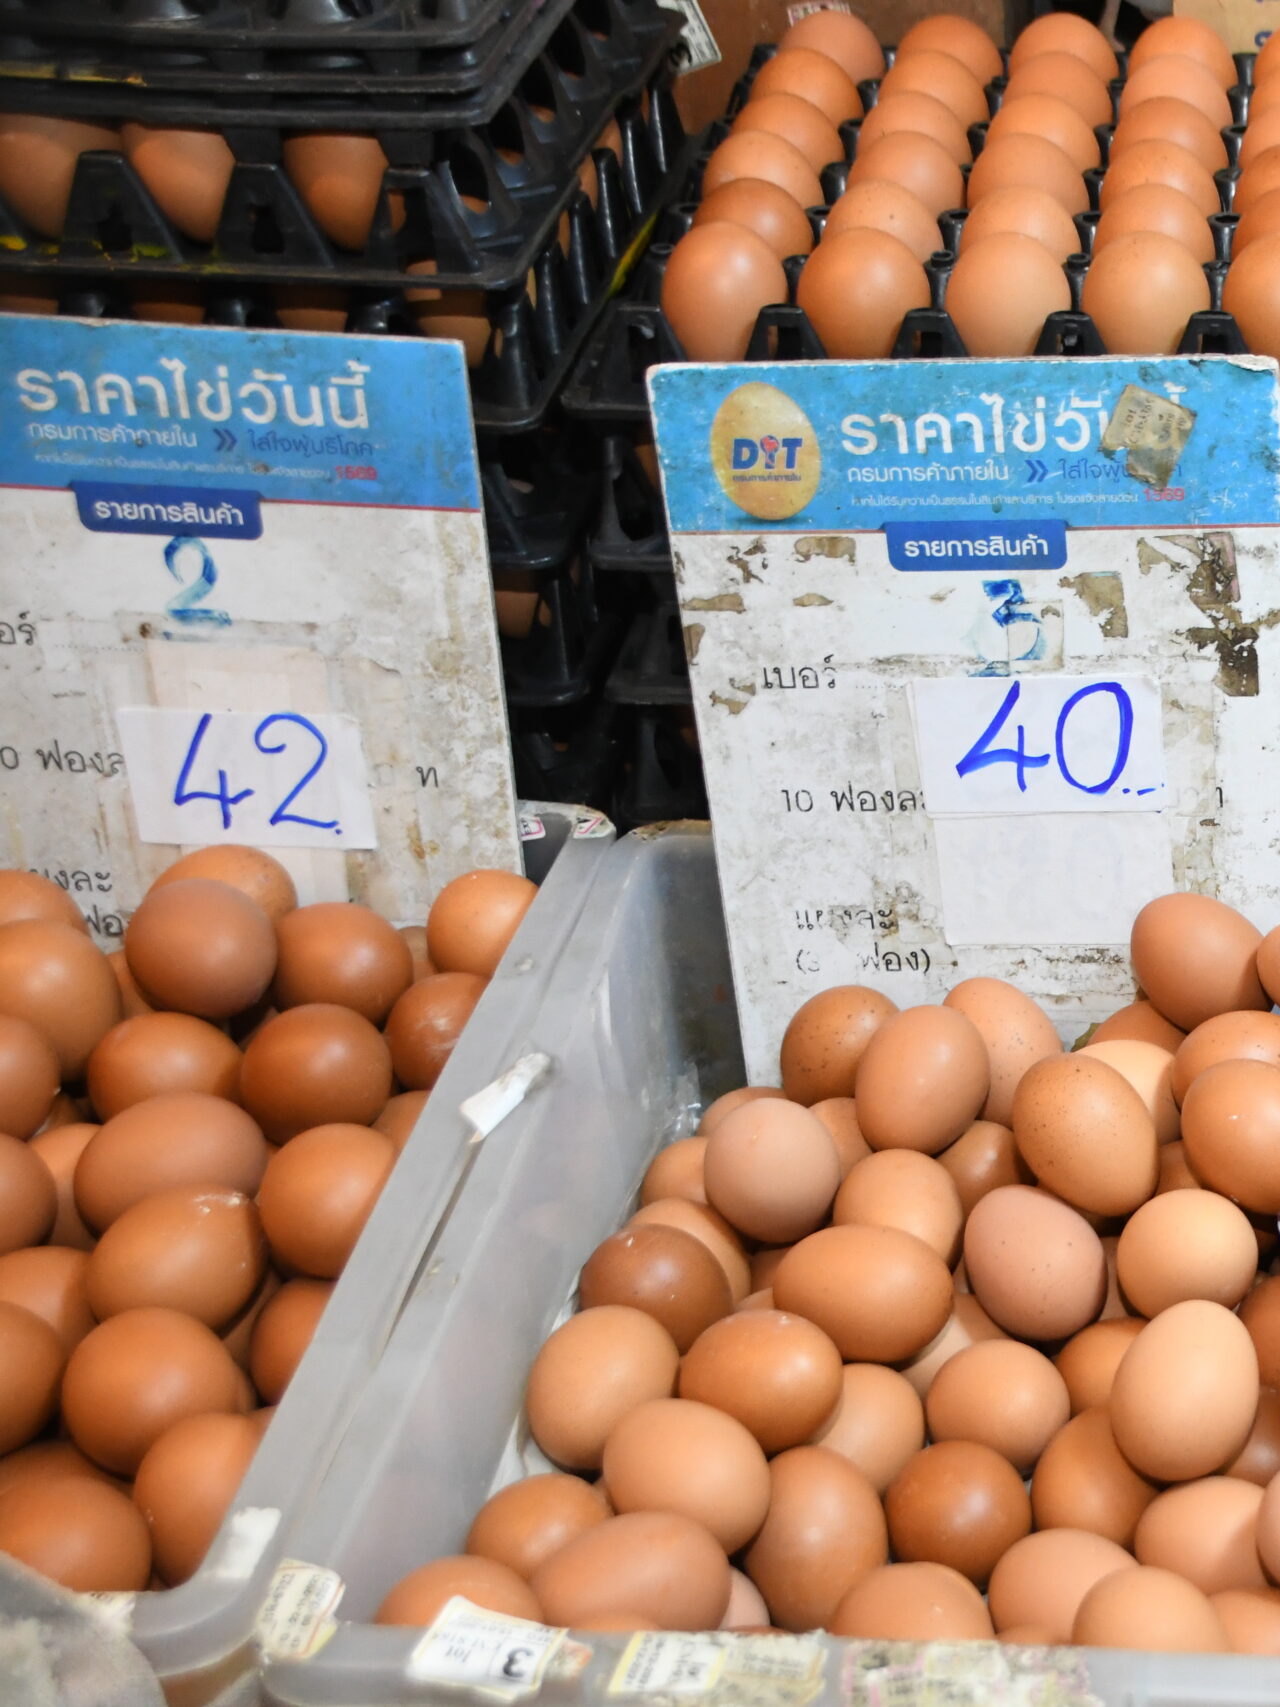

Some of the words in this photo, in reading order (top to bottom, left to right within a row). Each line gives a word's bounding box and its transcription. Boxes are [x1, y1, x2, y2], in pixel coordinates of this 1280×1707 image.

[16, 356, 372, 430] ราคาไข่วันนี้
[28, 421, 198, 449] กรมการค้าภายใน
[847, 458, 1009, 482] กรมการค้าภายใน
[1143, 487, 1185, 502] 1569
[94, 499, 245, 526] รายการสินค้า
[904, 534, 1049, 559] รายการสินค้า
[163, 535, 234, 628] 2
[761, 653, 838, 691] เบอร์
[781, 789, 814, 812] 10
